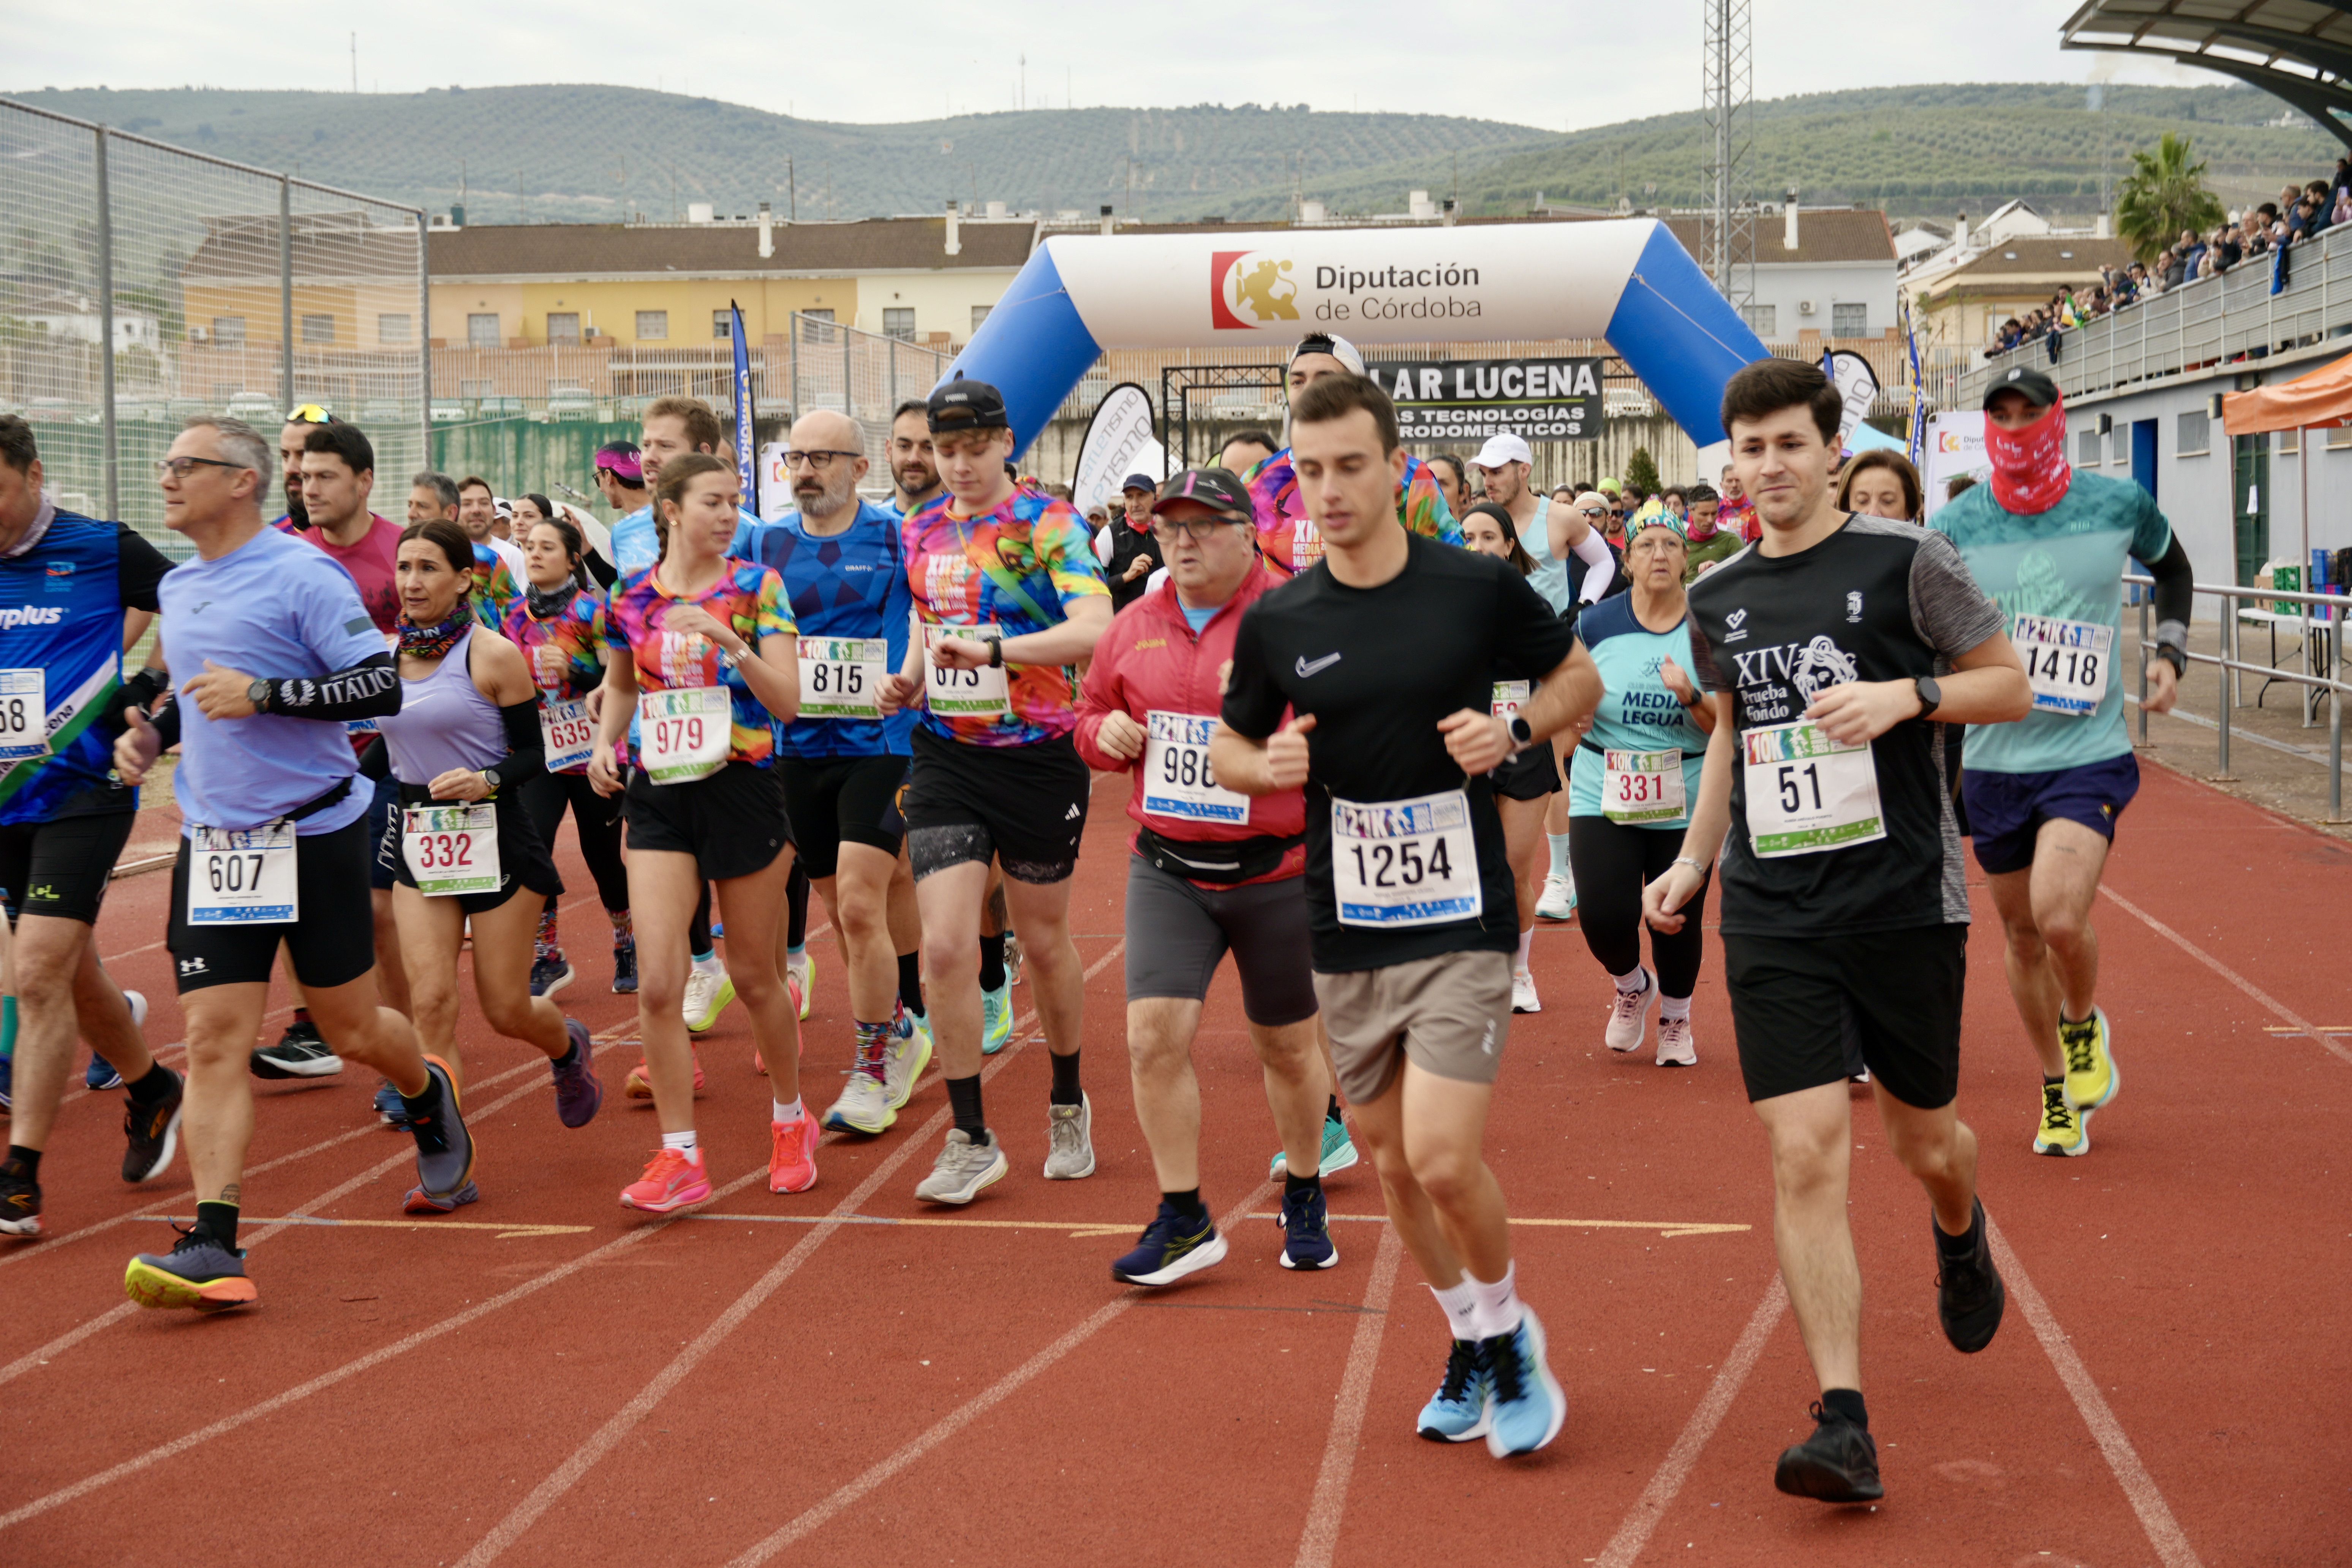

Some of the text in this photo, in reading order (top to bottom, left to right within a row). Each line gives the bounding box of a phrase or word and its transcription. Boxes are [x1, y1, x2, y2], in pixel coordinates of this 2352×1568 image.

[1316, 262, 1479, 295] Diputación
[1315, 296, 1481, 321] de Córdoba
[1456, 364, 1598, 399] LUCENA
[1421, 406, 1585, 423] TECNOLOGÍAS
[1398, 423, 1581, 438] RODOMESTICOS
[1293, 543, 1320, 555] MEDIA
[806, 640, 830, 659] 10K
[814, 664, 862, 693] 815
[1732, 643, 1800, 688] XIV
[2026, 645, 2098, 685] 1418
[1622, 691, 1686, 710] MEDIA
[1740, 684, 1788, 705] Prueba
[1622, 710, 1684, 726] LEGUA
[1747, 700, 1789, 722] Fondo
[551, 718, 591, 748] 635
[657, 718, 703, 754] 979
[1751, 732, 1785, 763] 10K
[1611, 753, 1633, 771] 10K
[1620, 774, 1661, 801] 331
[1778, 763, 1822, 813] 51
[1347, 808, 1389, 838] 21K
[420, 833, 473, 868] 332
[1351, 837, 1452, 887] 1254
[210, 855, 263, 892] 607
